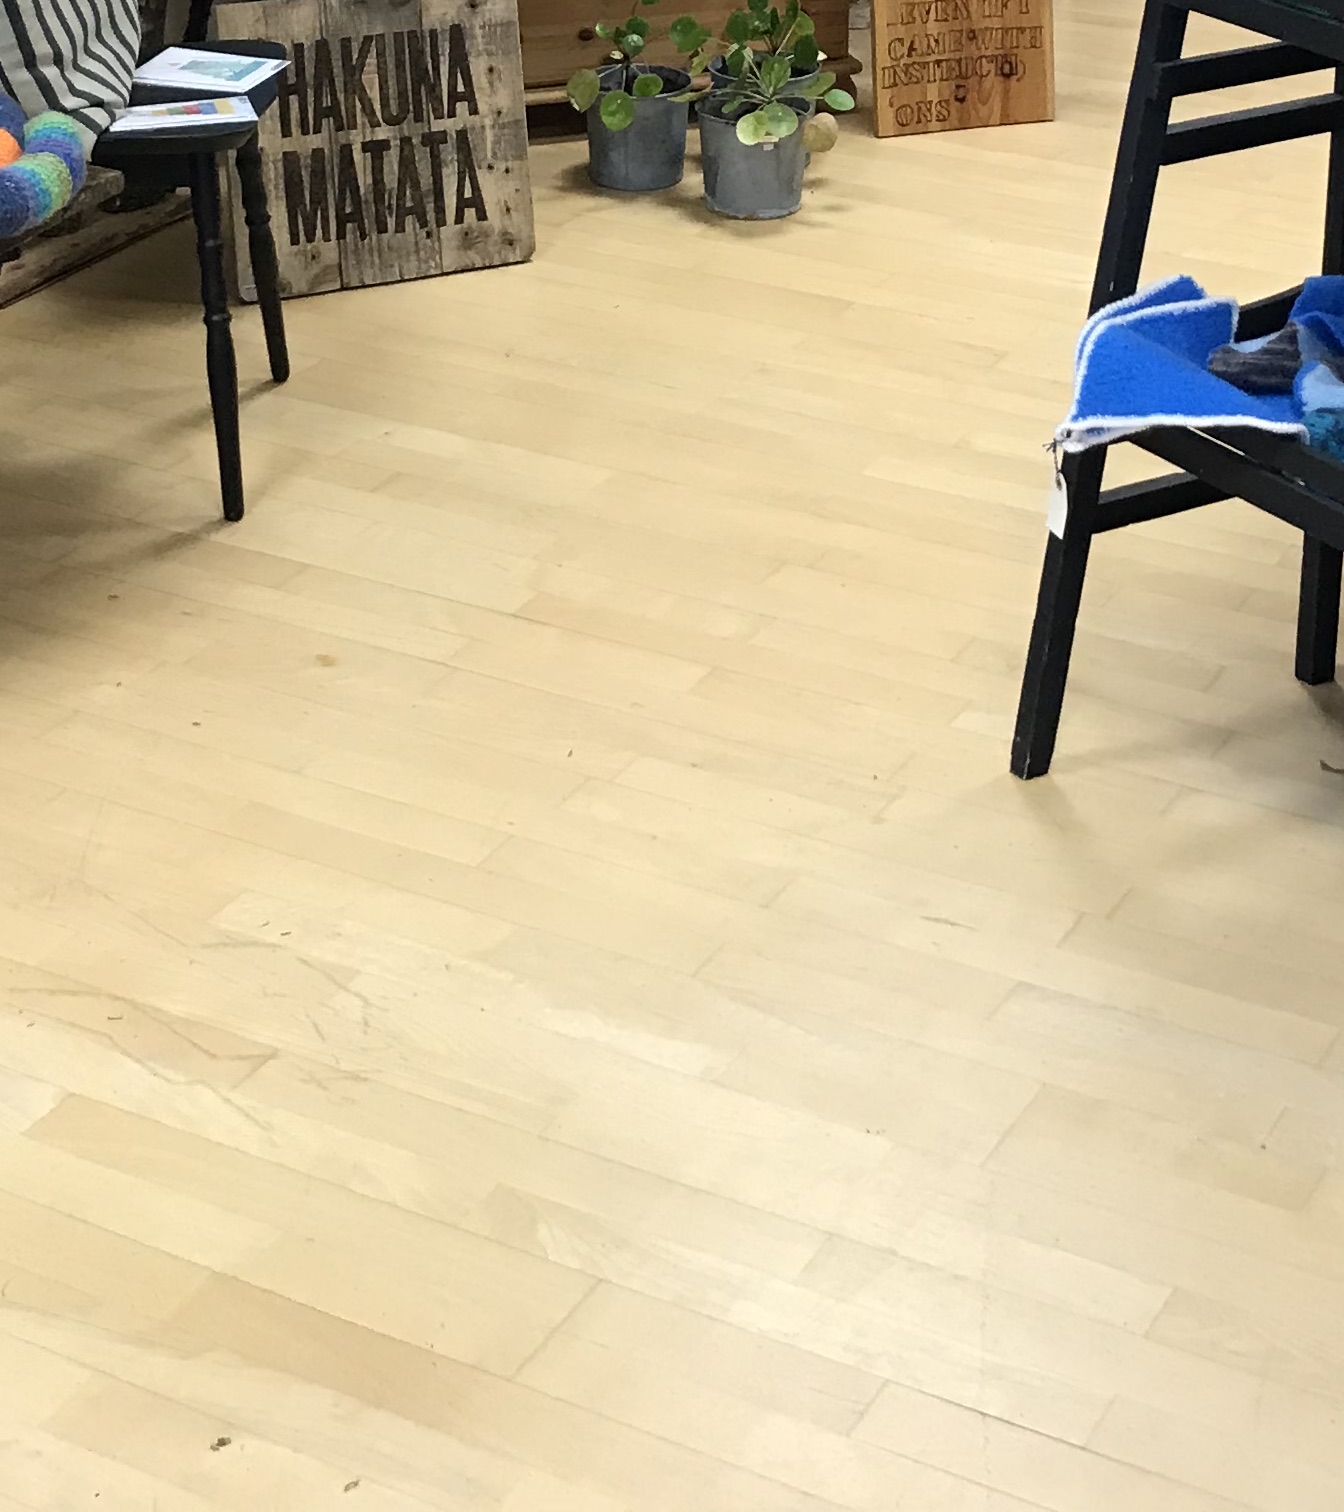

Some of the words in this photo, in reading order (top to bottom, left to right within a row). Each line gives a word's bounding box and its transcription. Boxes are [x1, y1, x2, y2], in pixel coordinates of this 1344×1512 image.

[277, 23, 479, 138] HAKUNA
[975, 25, 1045, 52] WITH
[282, 128, 489, 246] MATATA
